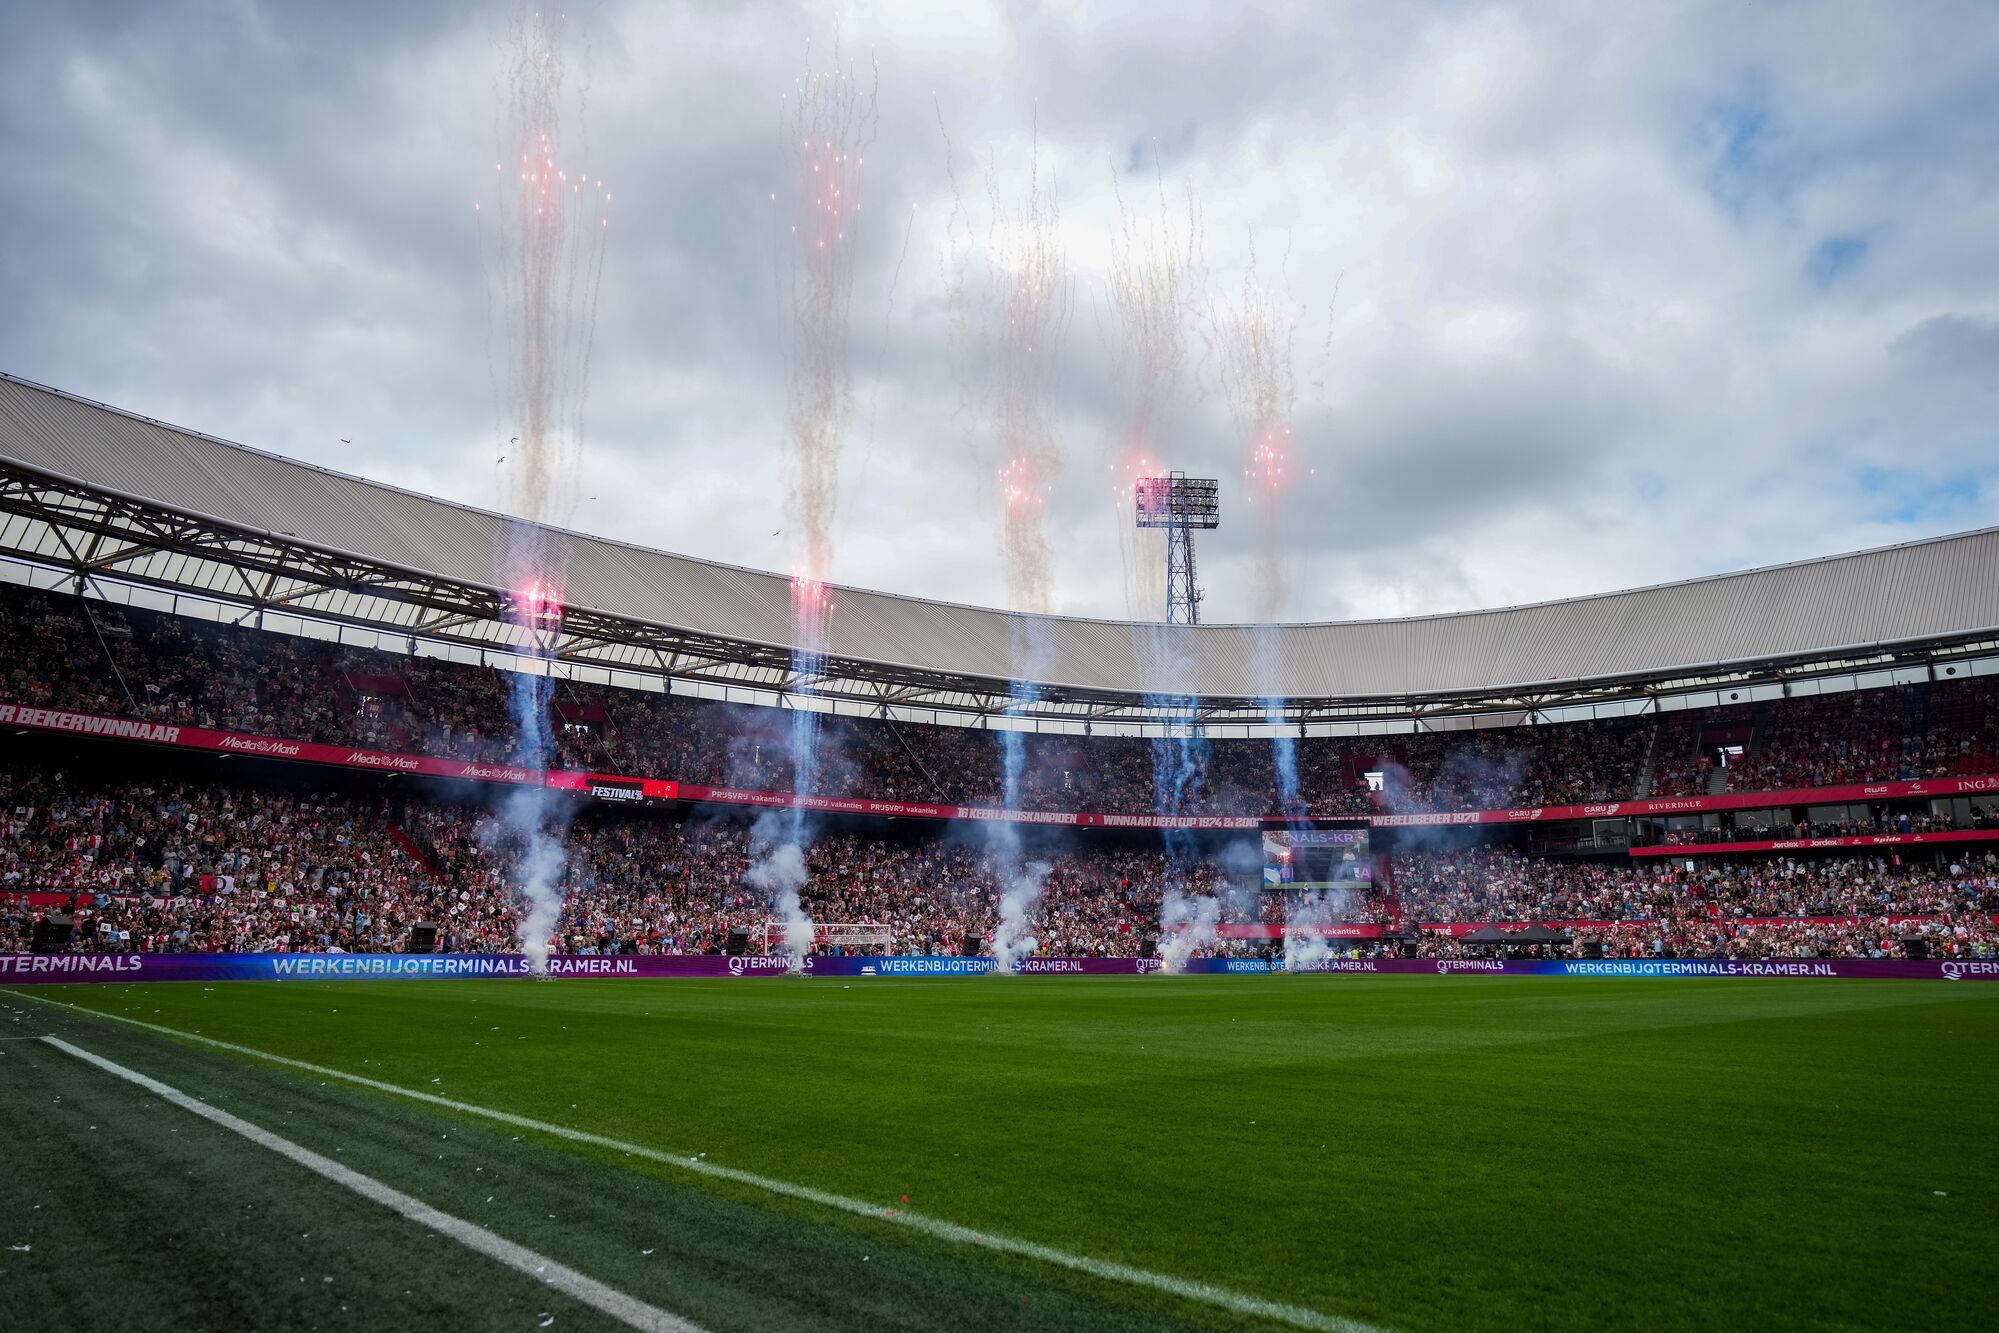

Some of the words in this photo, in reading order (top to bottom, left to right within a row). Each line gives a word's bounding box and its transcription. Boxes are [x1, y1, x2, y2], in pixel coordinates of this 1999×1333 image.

[16, 707, 180, 742] BEKERWINNAAR
[1957, 780, 1985, 791] ING
[591, 786, 636, 800] FESTIVAL
[751, 795, 785, 804] vakanties
[830, 801, 863, 809] vakanties
[1648, 800, 1702, 810] RIVERDALE
[906, 806, 938, 815] vakanties
[957, 807, 969, 819] 16
[969, 808, 997, 820] KEER
[1103, 815, 1152, 827] WINNAAR
[1152, 815, 1177, 827] UEFA
[1177, 816, 1197, 828] CUP
[1198, 817, 1222, 828] 1974
[1372, 814, 1451, 826] WERELDBEKER
[1452, 812, 1480, 823] 1970
[1772, 841, 1799, 849] Jordex
[1809, 839, 1838, 847] Jordex
[1323, 927, 1360, 935] vakanties
[1565, 963, 1838, 976] WERKENBIJQTERMINALS-KRAMER.NL
